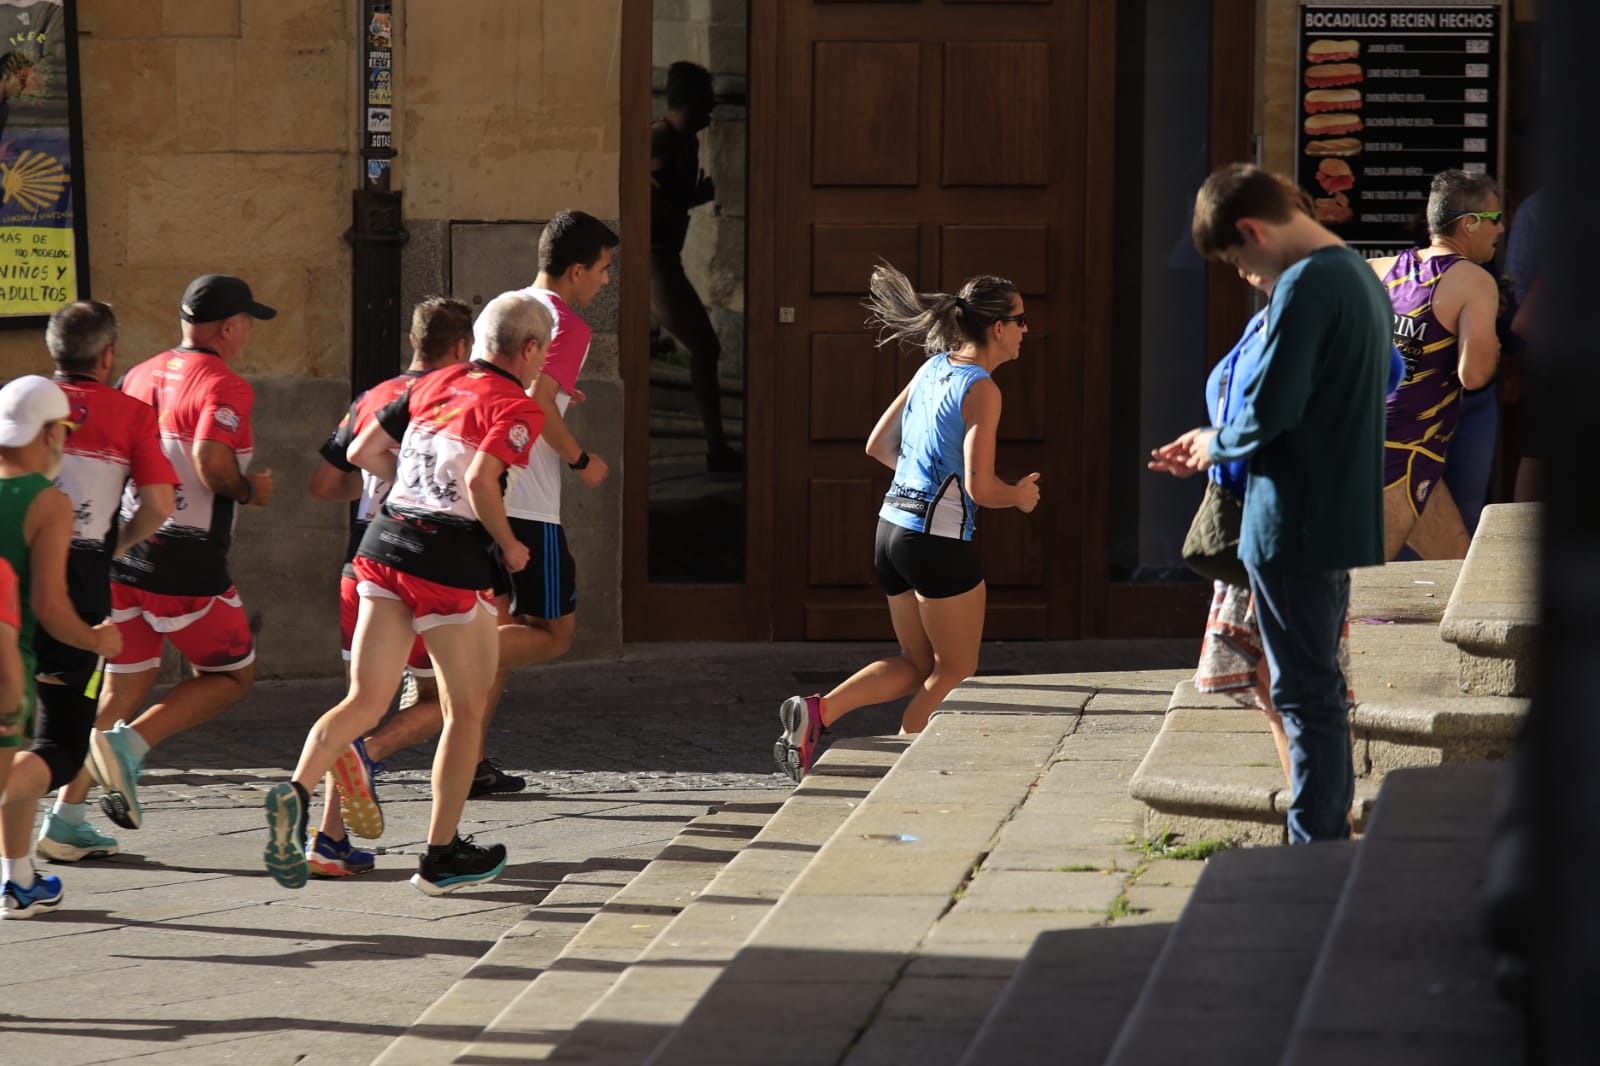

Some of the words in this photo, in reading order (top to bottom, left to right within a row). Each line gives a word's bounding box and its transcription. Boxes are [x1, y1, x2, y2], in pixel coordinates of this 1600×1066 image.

[1305, 13, 1387, 28] BOCADILLOS
[1390, 13, 1436, 28] RECIEN
[1439, 13, 1494, 28] HECHOS
[9, 31, 47, 47] IKER
[32, 234, 48, 245] DE
[57, 266, 67, 280] Y
[0, 284, 67, 302] ADULTOS
